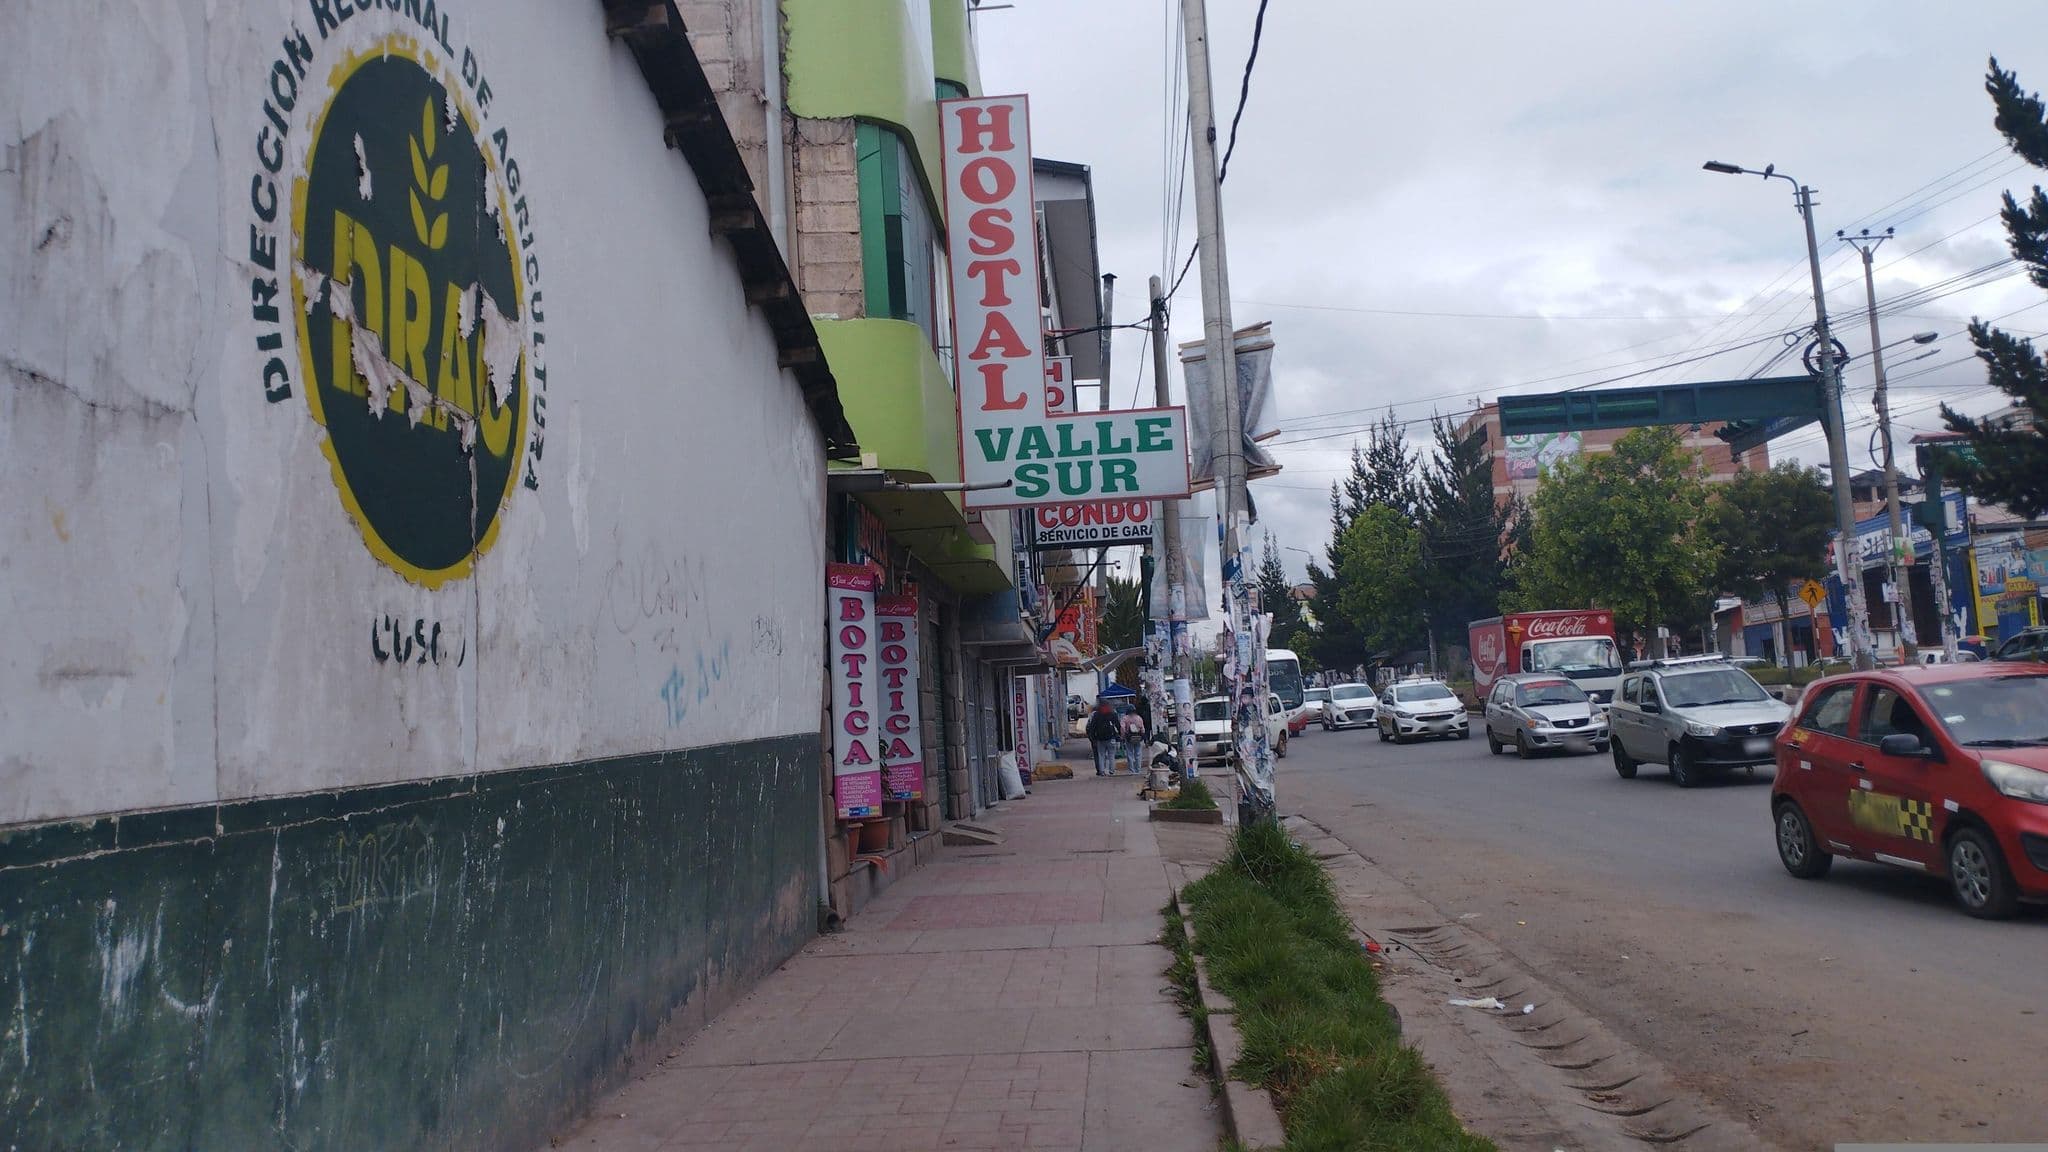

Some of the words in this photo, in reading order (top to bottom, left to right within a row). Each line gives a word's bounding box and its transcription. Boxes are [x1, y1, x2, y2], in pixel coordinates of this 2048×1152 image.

[955, 105, 1031, 411] HOSTAL
[975, 417, 1173, 462] VALLE
[1014, 458, 1139, 498] SUR
[1038, 501, 1152, 528] CONDO
[1040, 528, 1098, 542] SERVICIO
[1102, 526, 1119, 538] DE
[372, 614, 466, 668] CUSC
[839, 597, 873, 765] BOTICA
[881, 621, 914, 760] BOTICA
[1015, 692, 1029, 768] BOTICA
